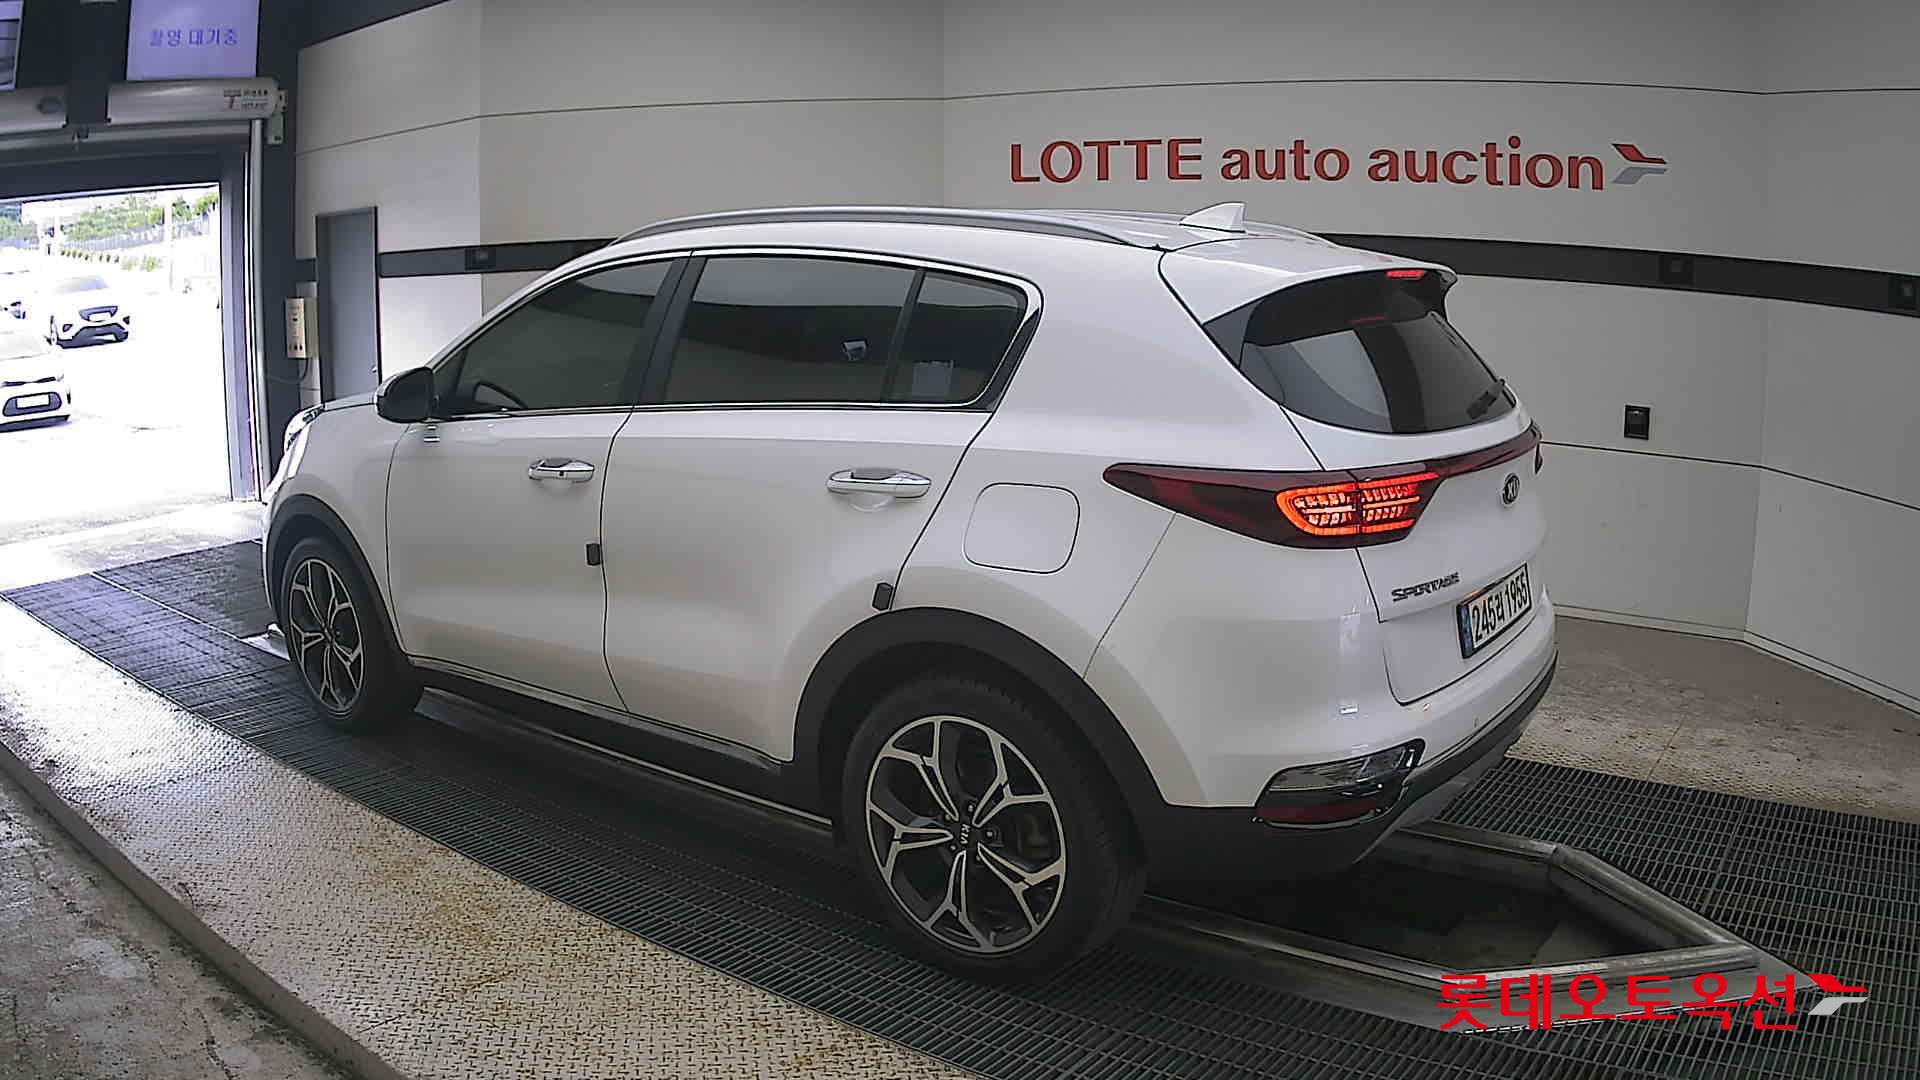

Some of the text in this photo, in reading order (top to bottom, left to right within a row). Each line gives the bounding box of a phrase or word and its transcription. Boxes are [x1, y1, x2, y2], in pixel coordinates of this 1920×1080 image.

[188, 28, 238, 45] 대기중
[1009, 135, 1604, 191] LOTTE auto auction
[1505, 571, 1528, 617] 1955
